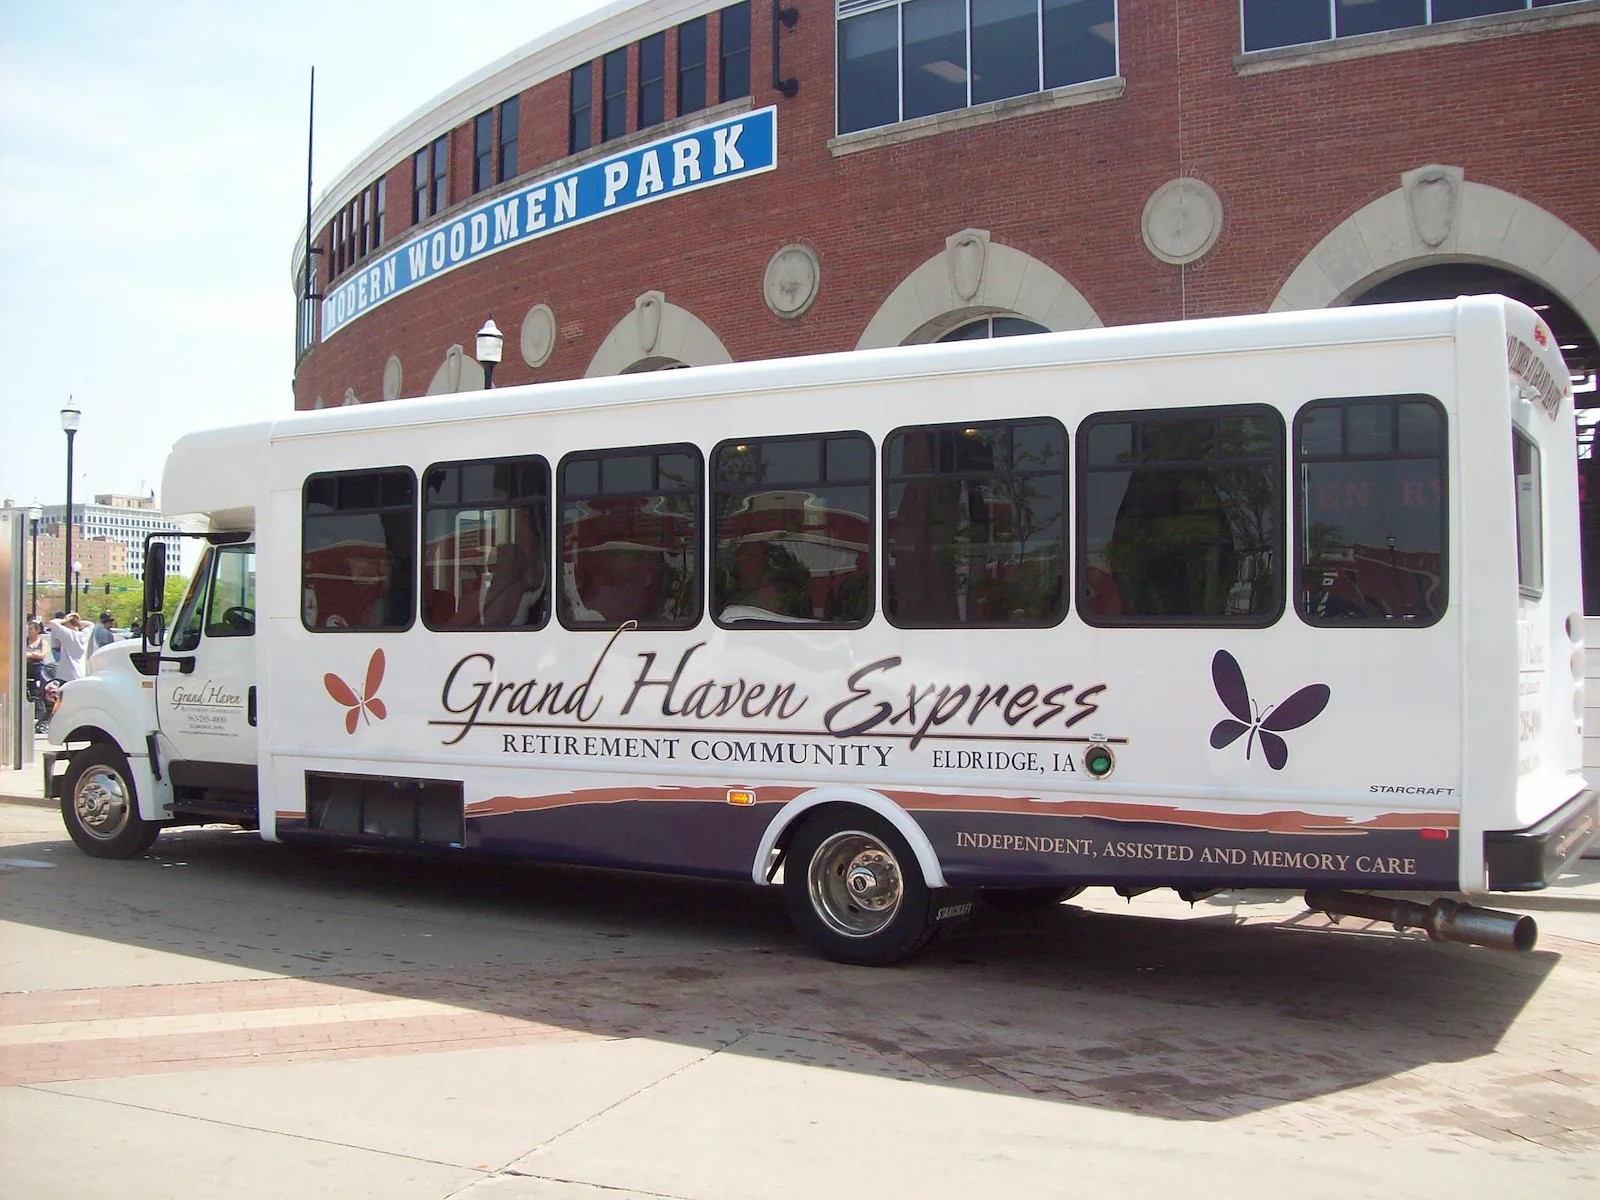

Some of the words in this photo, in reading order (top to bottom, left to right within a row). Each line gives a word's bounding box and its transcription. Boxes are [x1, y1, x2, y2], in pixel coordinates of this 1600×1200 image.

[327, 256, 397, 332] MODERN
[408, 176, 579, 281] WOODMEN
[604, 123, 746, 207] PARK
[172, 680, 212, 710] Grand
[208, 685, 243, 704] Haven
[441, 619, 638, 746] Grand
[619, 640, 809, 720] Haven
[823, 655, 1107, 751] Express
[502, 733, 681, 760] RETIREMENT
[691, 740, 894, 768] COMMUNITY
[932, 749, 1045, 775] ELDRIDGE,
[1053, 752, 1077, 773] IA
[1369, 785, 1456, 796] STARCRAFT
[956, 831, 1098, 859] INDEPENDENT,
[1102, 841, 1194, 863] ASSISTED
[1200, 846, 1247, 866] AND
[1252, 850, 1351, 872] MEMORY
[1355, 855, 1417, 876] CARE
